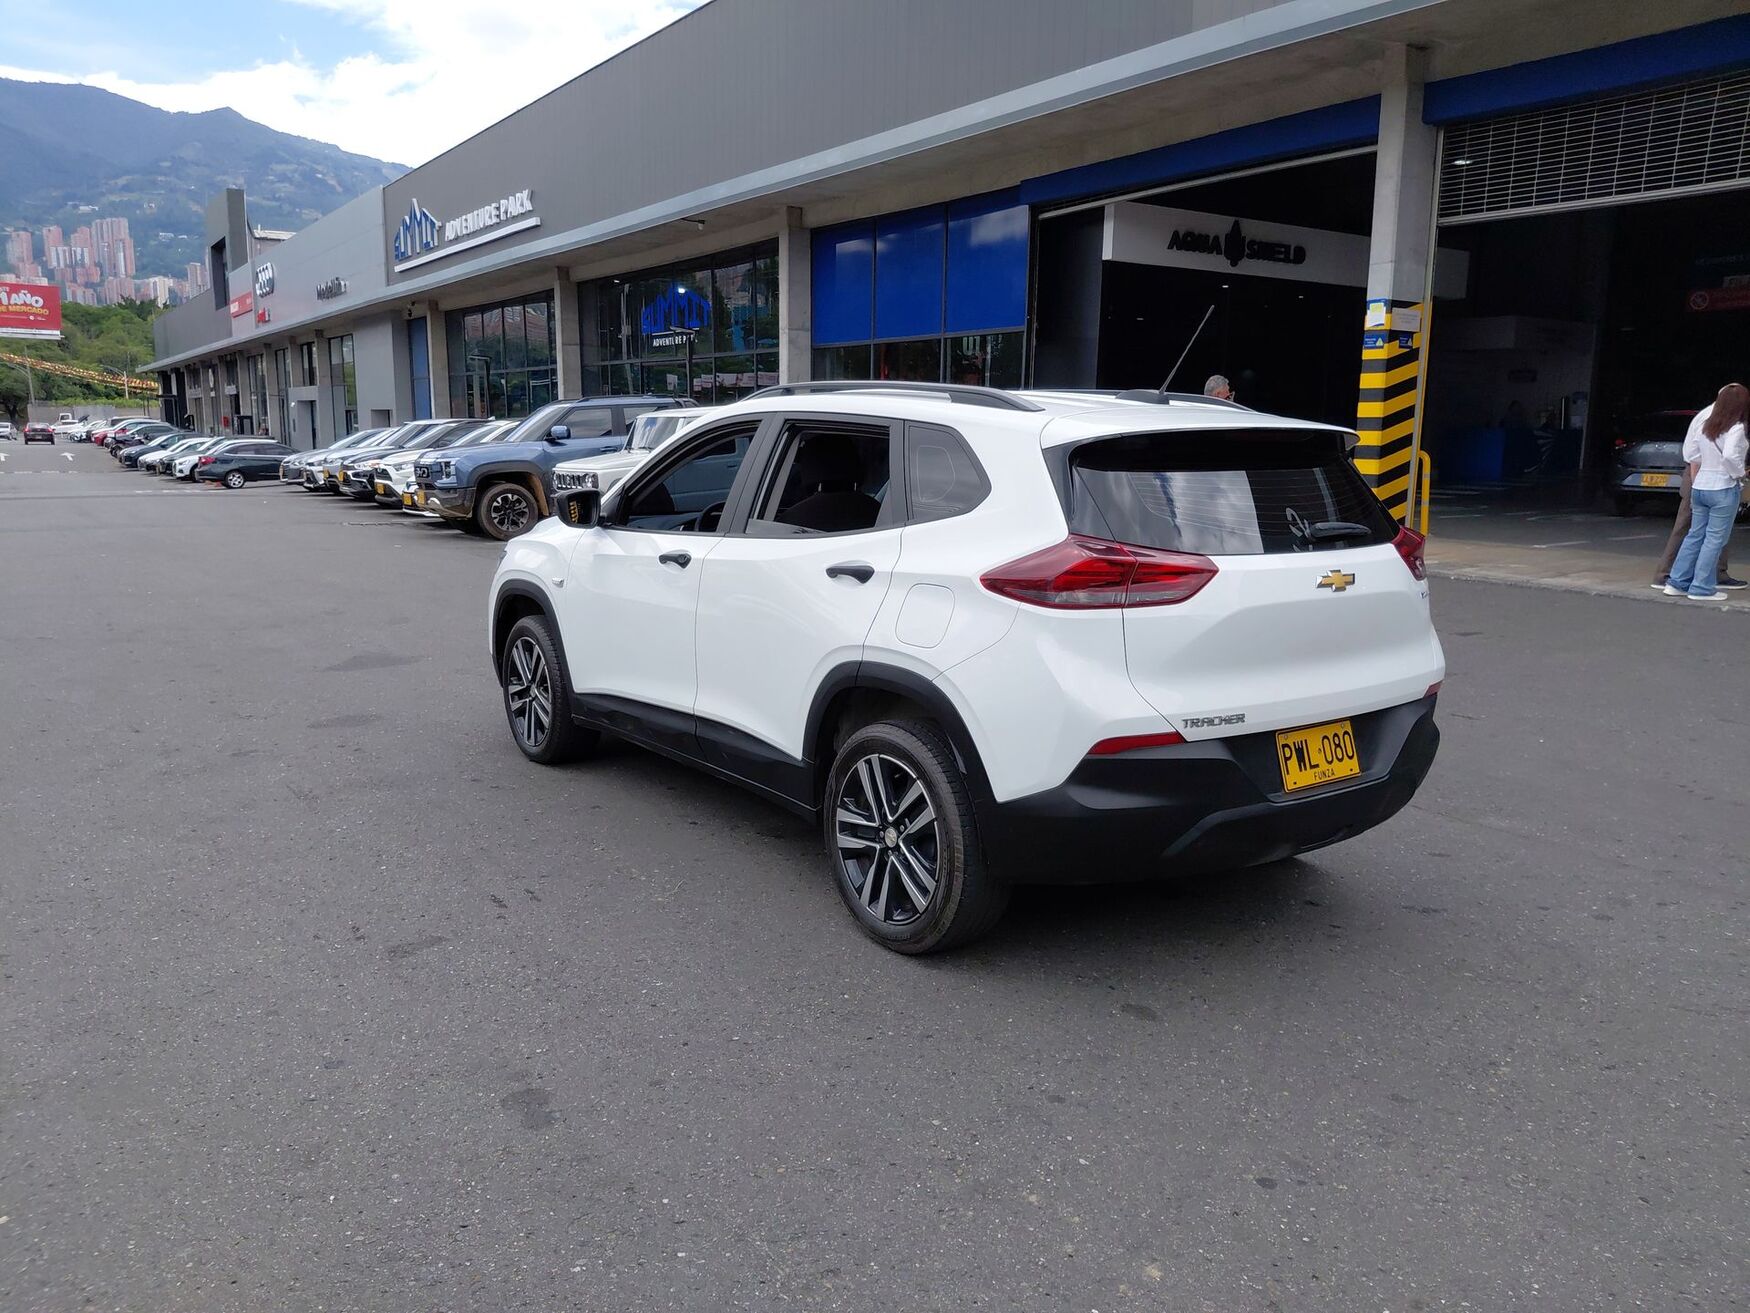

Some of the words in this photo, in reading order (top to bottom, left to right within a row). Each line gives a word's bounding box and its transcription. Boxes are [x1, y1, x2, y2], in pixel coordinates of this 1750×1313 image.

[445, 202, 500, 241] ADVENTURE
[500, 189, 533, 220] PARK
[1167, 229, 1222, 255] AQUA
[1246, 239, 1306, 264] SHIELD
[8, 305, 49, 315] MERCADO
[10, 290, 44, 308] AÑO
[642, 281, 711, 335] SUMMIT
[1181, 713, 1246, 729] TRACKER
[1281, 739, 1320, 775] PWL
[1321, 730, 1355, 765] 080
[1314, 768, 1336, 781] FUNZA
